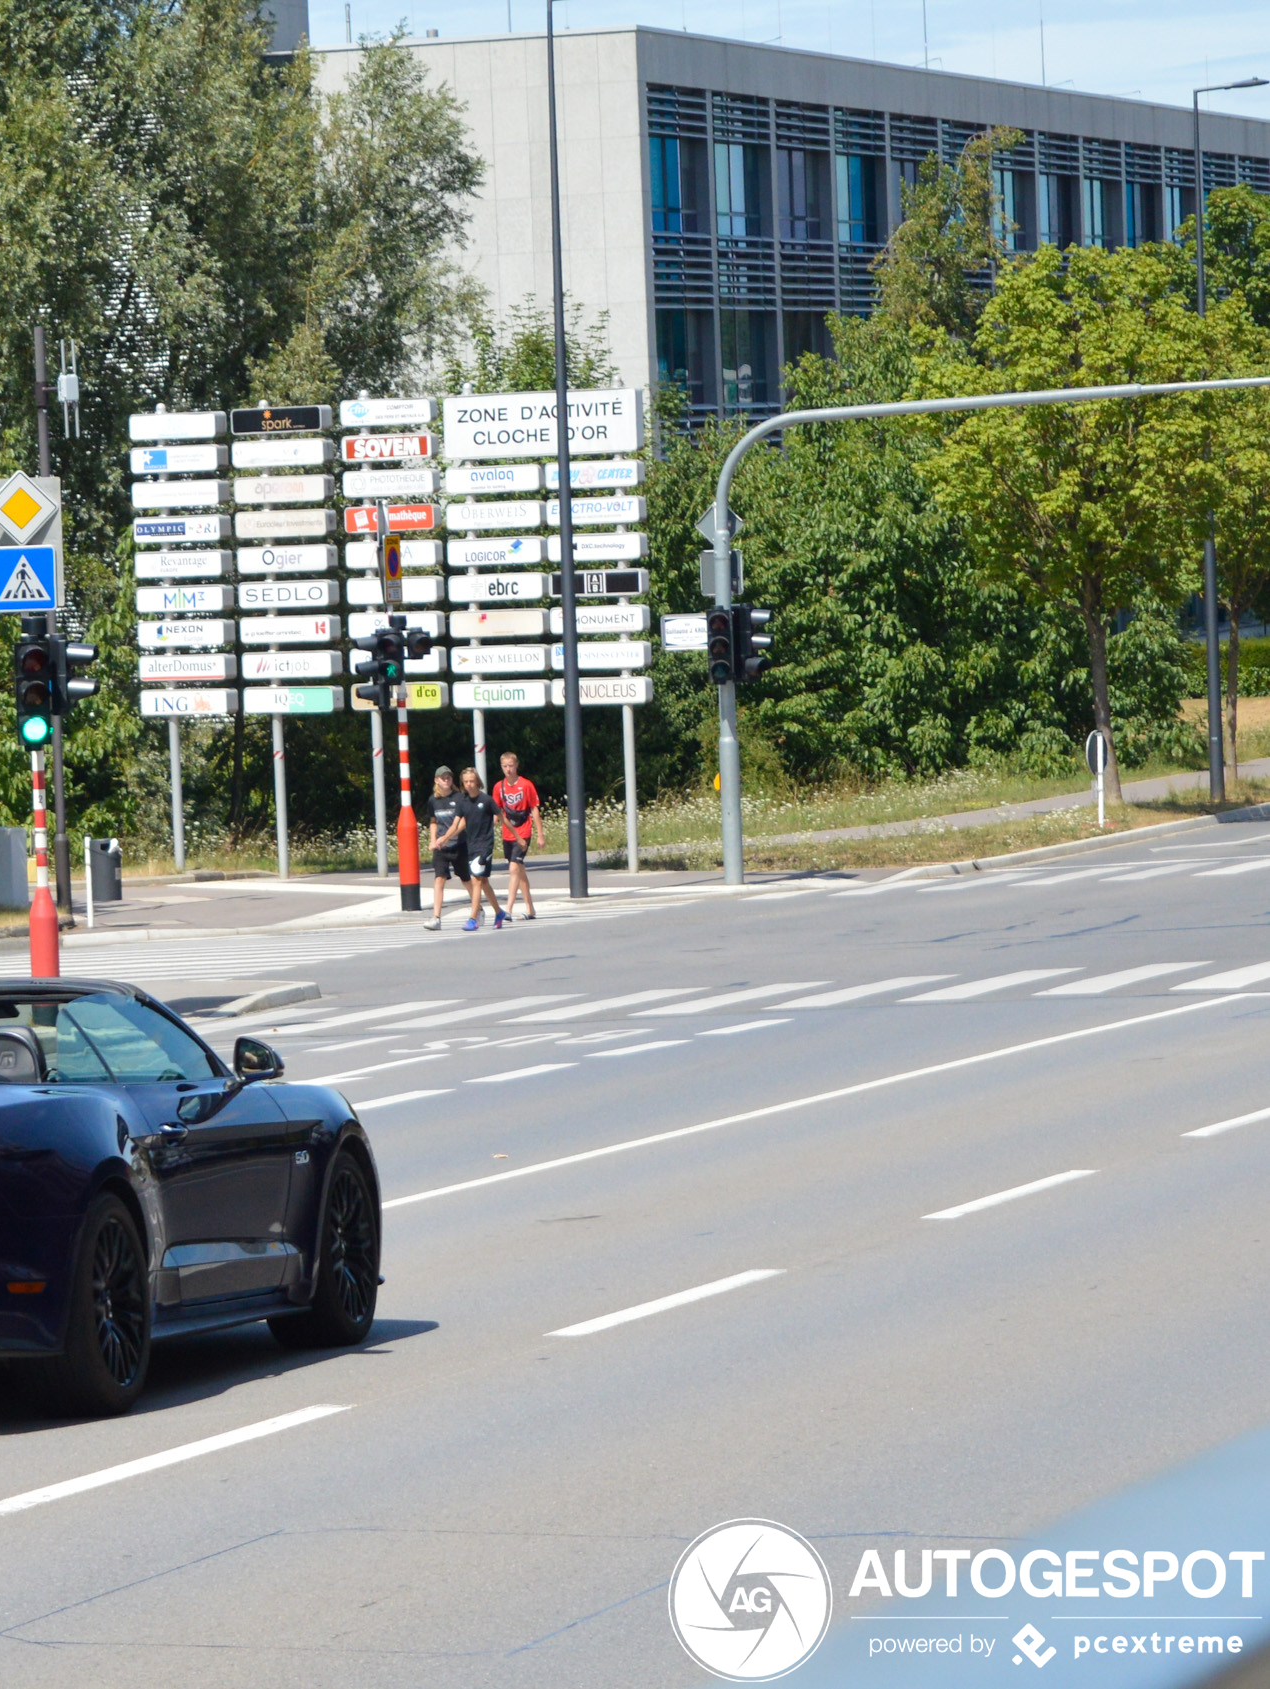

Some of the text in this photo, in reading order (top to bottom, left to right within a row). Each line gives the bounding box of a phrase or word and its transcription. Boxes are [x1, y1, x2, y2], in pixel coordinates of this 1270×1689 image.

[457, 407, 508, 424] ZONE
[262, 418, 291, 432] spark
[473, 428, 550, 446] CLOCHE
[354, 436, 421, 458] SOVEM
[370, 473, 426, 484] PHOTOTHEQUE
[470, 468, 514, 482] avaloq
[597, 468, 634, 480] CENTER
[551, 501, 634, 515] ECTRO-VOLT
[136, 525, 184, 533] OLYMPIC
[161, 555, 207, 568] Revantage
[262, 550, 302, 569] Ogier
[465, 551, 506, 562] LOGICOR
[246, 586, 323, 602] SEDLO
[488, 578, 519, 596] ebrc
[165, 625, 203, 634] NEXON
[475, 652, 540, 664] BNY MELLON
[148, 659, 212, 673] alterDomus
[274, 658, 310, 675] ictjob
[473, 686, 526, 705] Equiom
[580, 683, 637, 698] NUCLEUS
[154, 696, 188, 712] ING
[501, 791, 524, 806] SA
